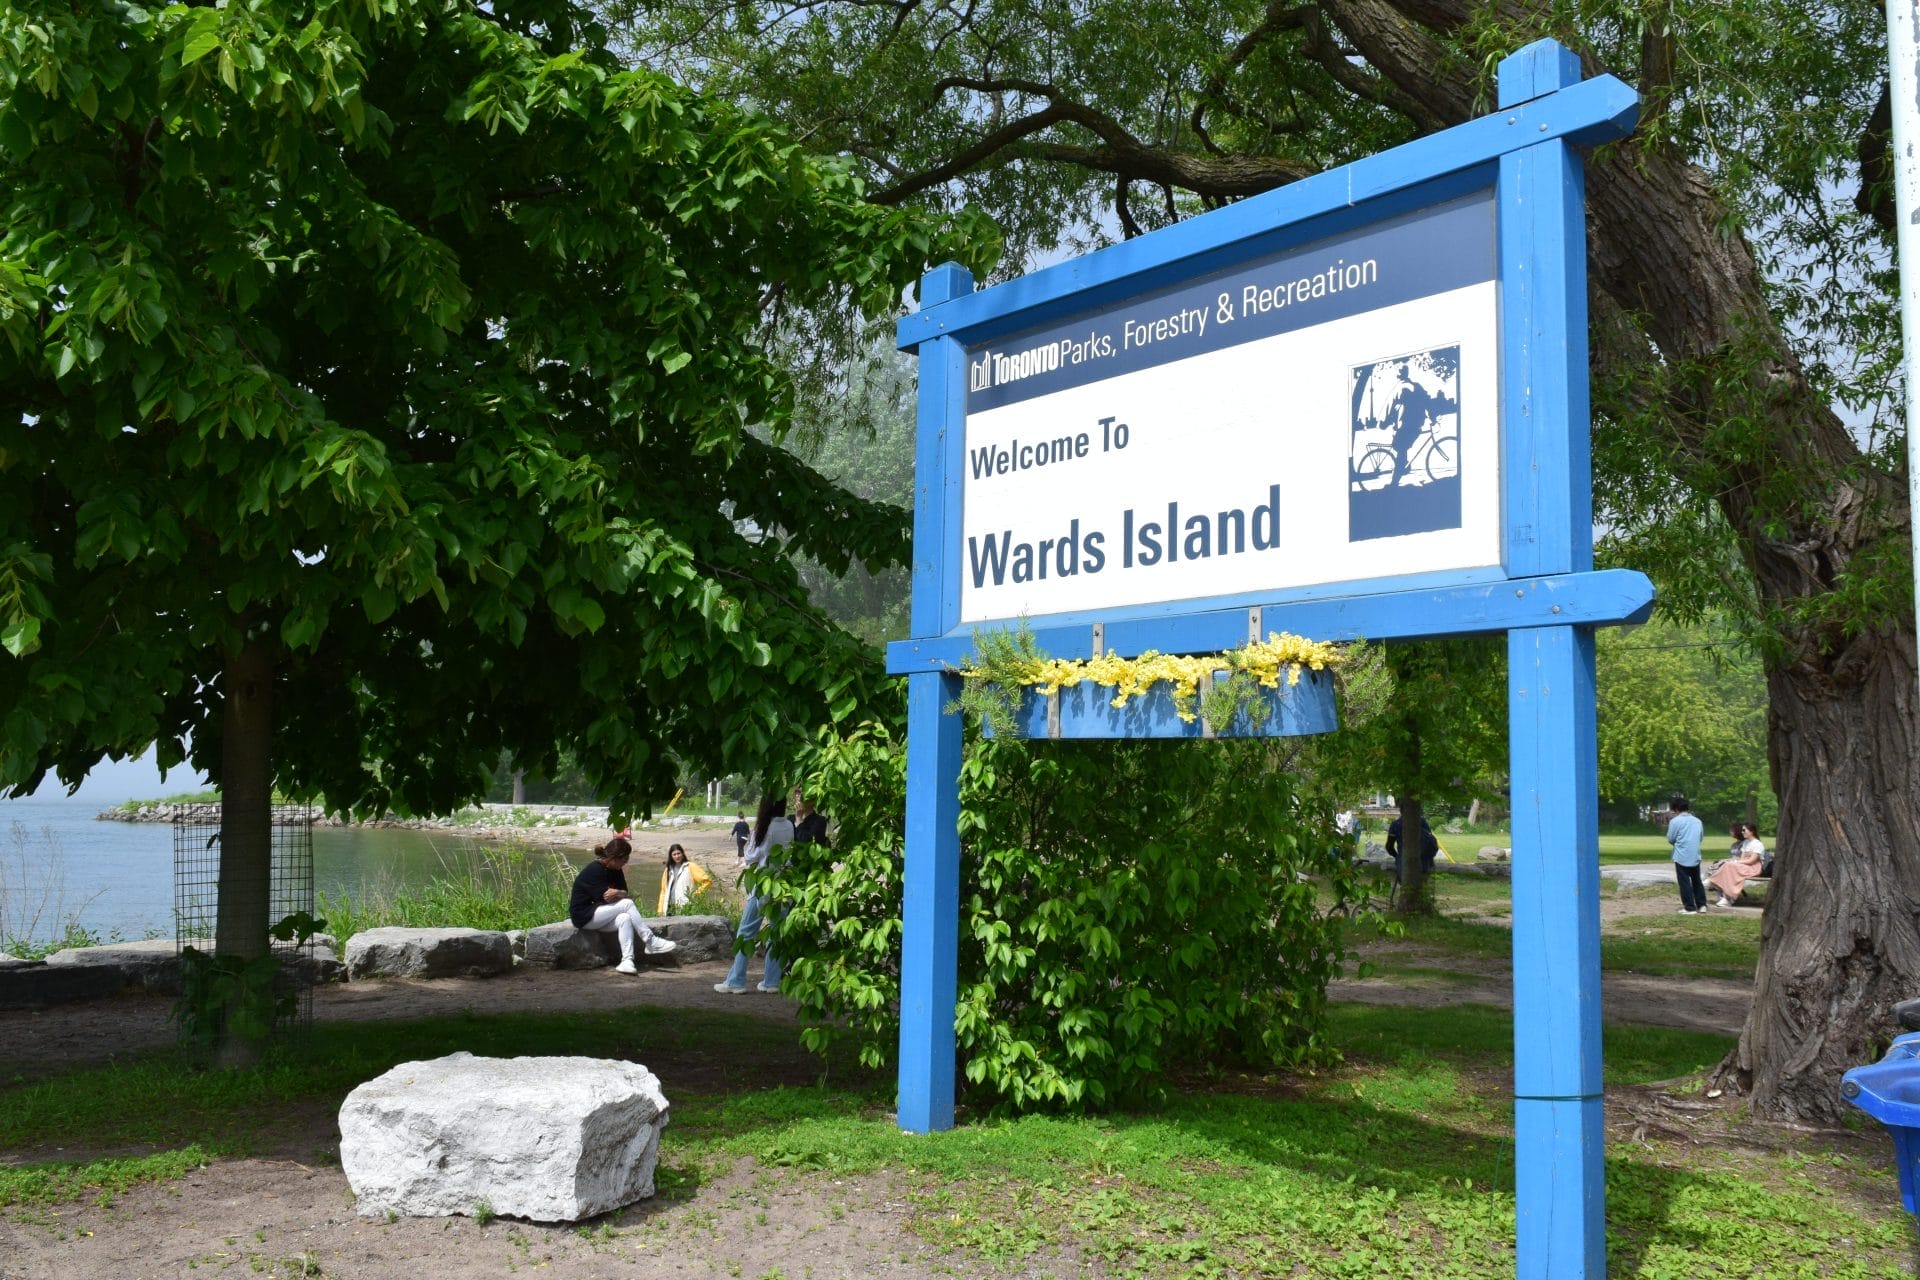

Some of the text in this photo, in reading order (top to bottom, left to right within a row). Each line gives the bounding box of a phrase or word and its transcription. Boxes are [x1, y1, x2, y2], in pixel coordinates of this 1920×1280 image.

[1124, 305, 1209, 351] Forestry
[1216, 292, 1235, 324] &
[1242, 258, 1378, 318] Recreation
[970, 415, 1130, 480] Welcome To
[968, 483, 1281, 589] Wards Island
